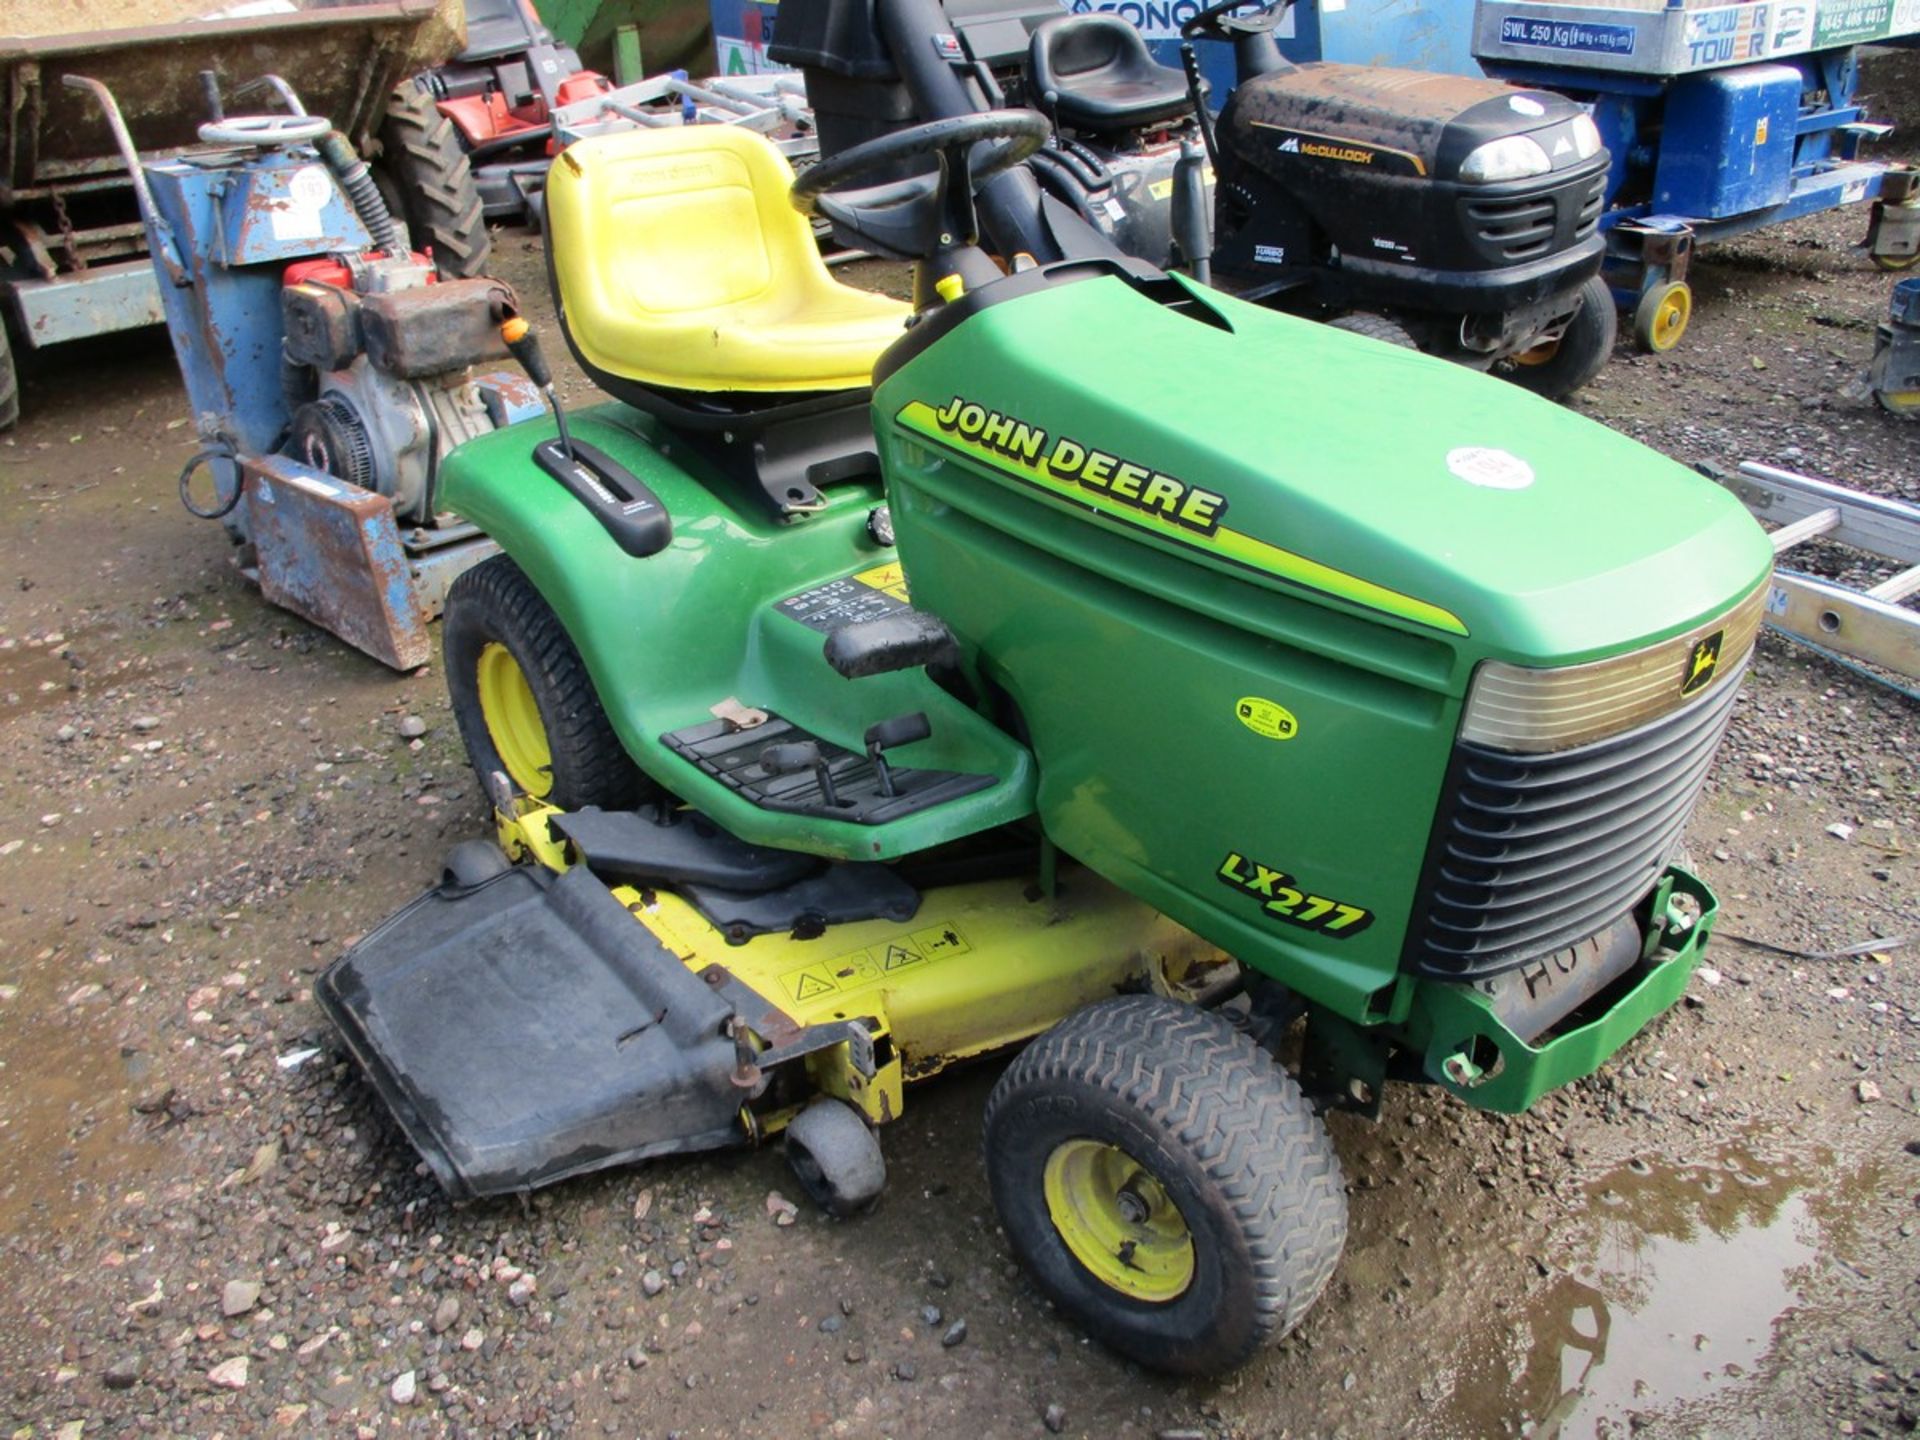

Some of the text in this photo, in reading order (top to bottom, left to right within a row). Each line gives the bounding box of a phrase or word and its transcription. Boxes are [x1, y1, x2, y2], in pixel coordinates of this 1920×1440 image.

[1503, 21, 1528, 39] SWL
[1530, 26, 1551, 42] 250
[1693, 4, 1768, 34] POWER
[1689, 32, 1765, 66] TOWER
[1301, 142, 1374, 165] McCULLOCH
[1254, 245, 1285, 257] TURBO
[937, 397, 1229, 538] JOHN DEERE
[1217, 852, 1375, 939] LX277
